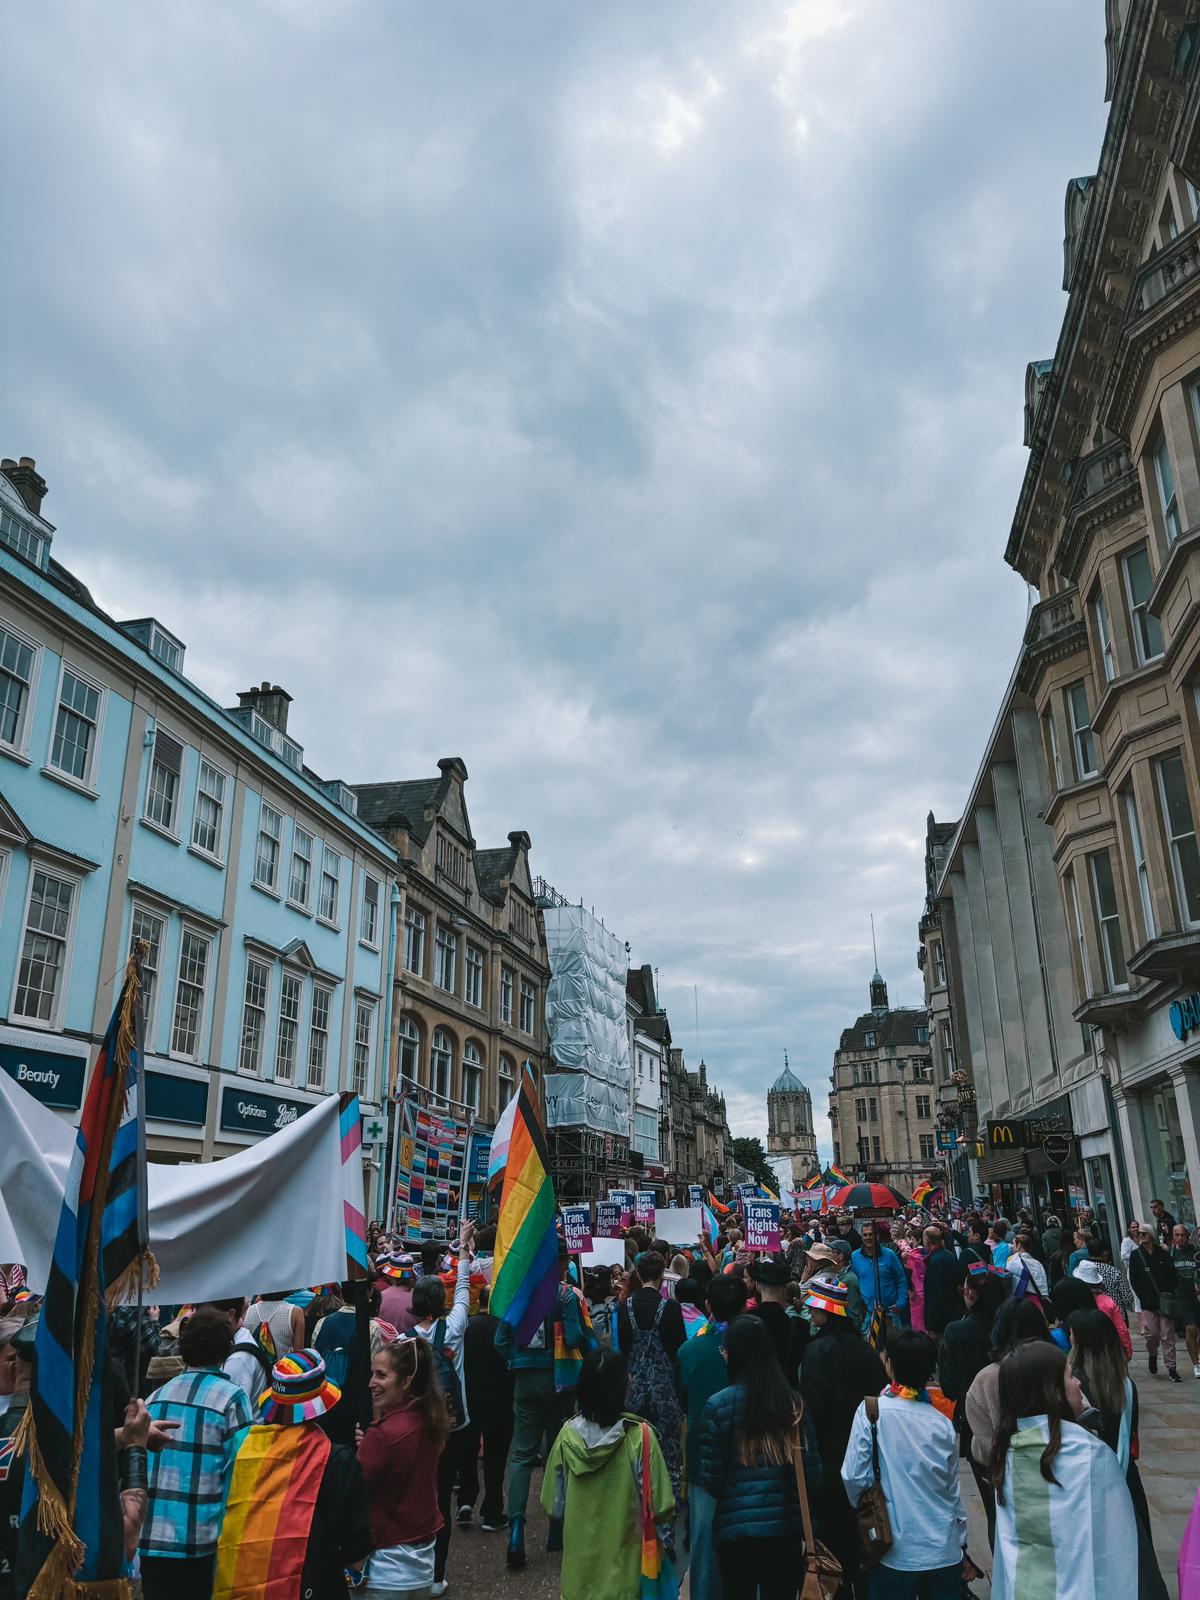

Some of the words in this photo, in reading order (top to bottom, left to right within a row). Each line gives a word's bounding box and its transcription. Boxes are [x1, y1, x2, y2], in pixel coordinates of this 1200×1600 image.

[17, 1063, 60, 1089] Beauty
[238, 1101, 267, 1119] Opticians
[609, 1193, 627, 1204] Trans
[636, 1194, 652, 1203] Trans
[597, 1206, 616, 1216] Trans
[637, 1203, 655, 1212] Rights
[746, 1204, 771, 1218] Trans
[562, 1212, 584, 1224] Trans
[598, 1216, 620, 1228] Rights
[565, 1223, 591, 1239] Rights
[597, 1226, 612, 1237] Now
[747, 1218, 779, 1235] Rights
[566, 1236, 583, 1249] Now
[748, 1231, 769, 1245] Now
